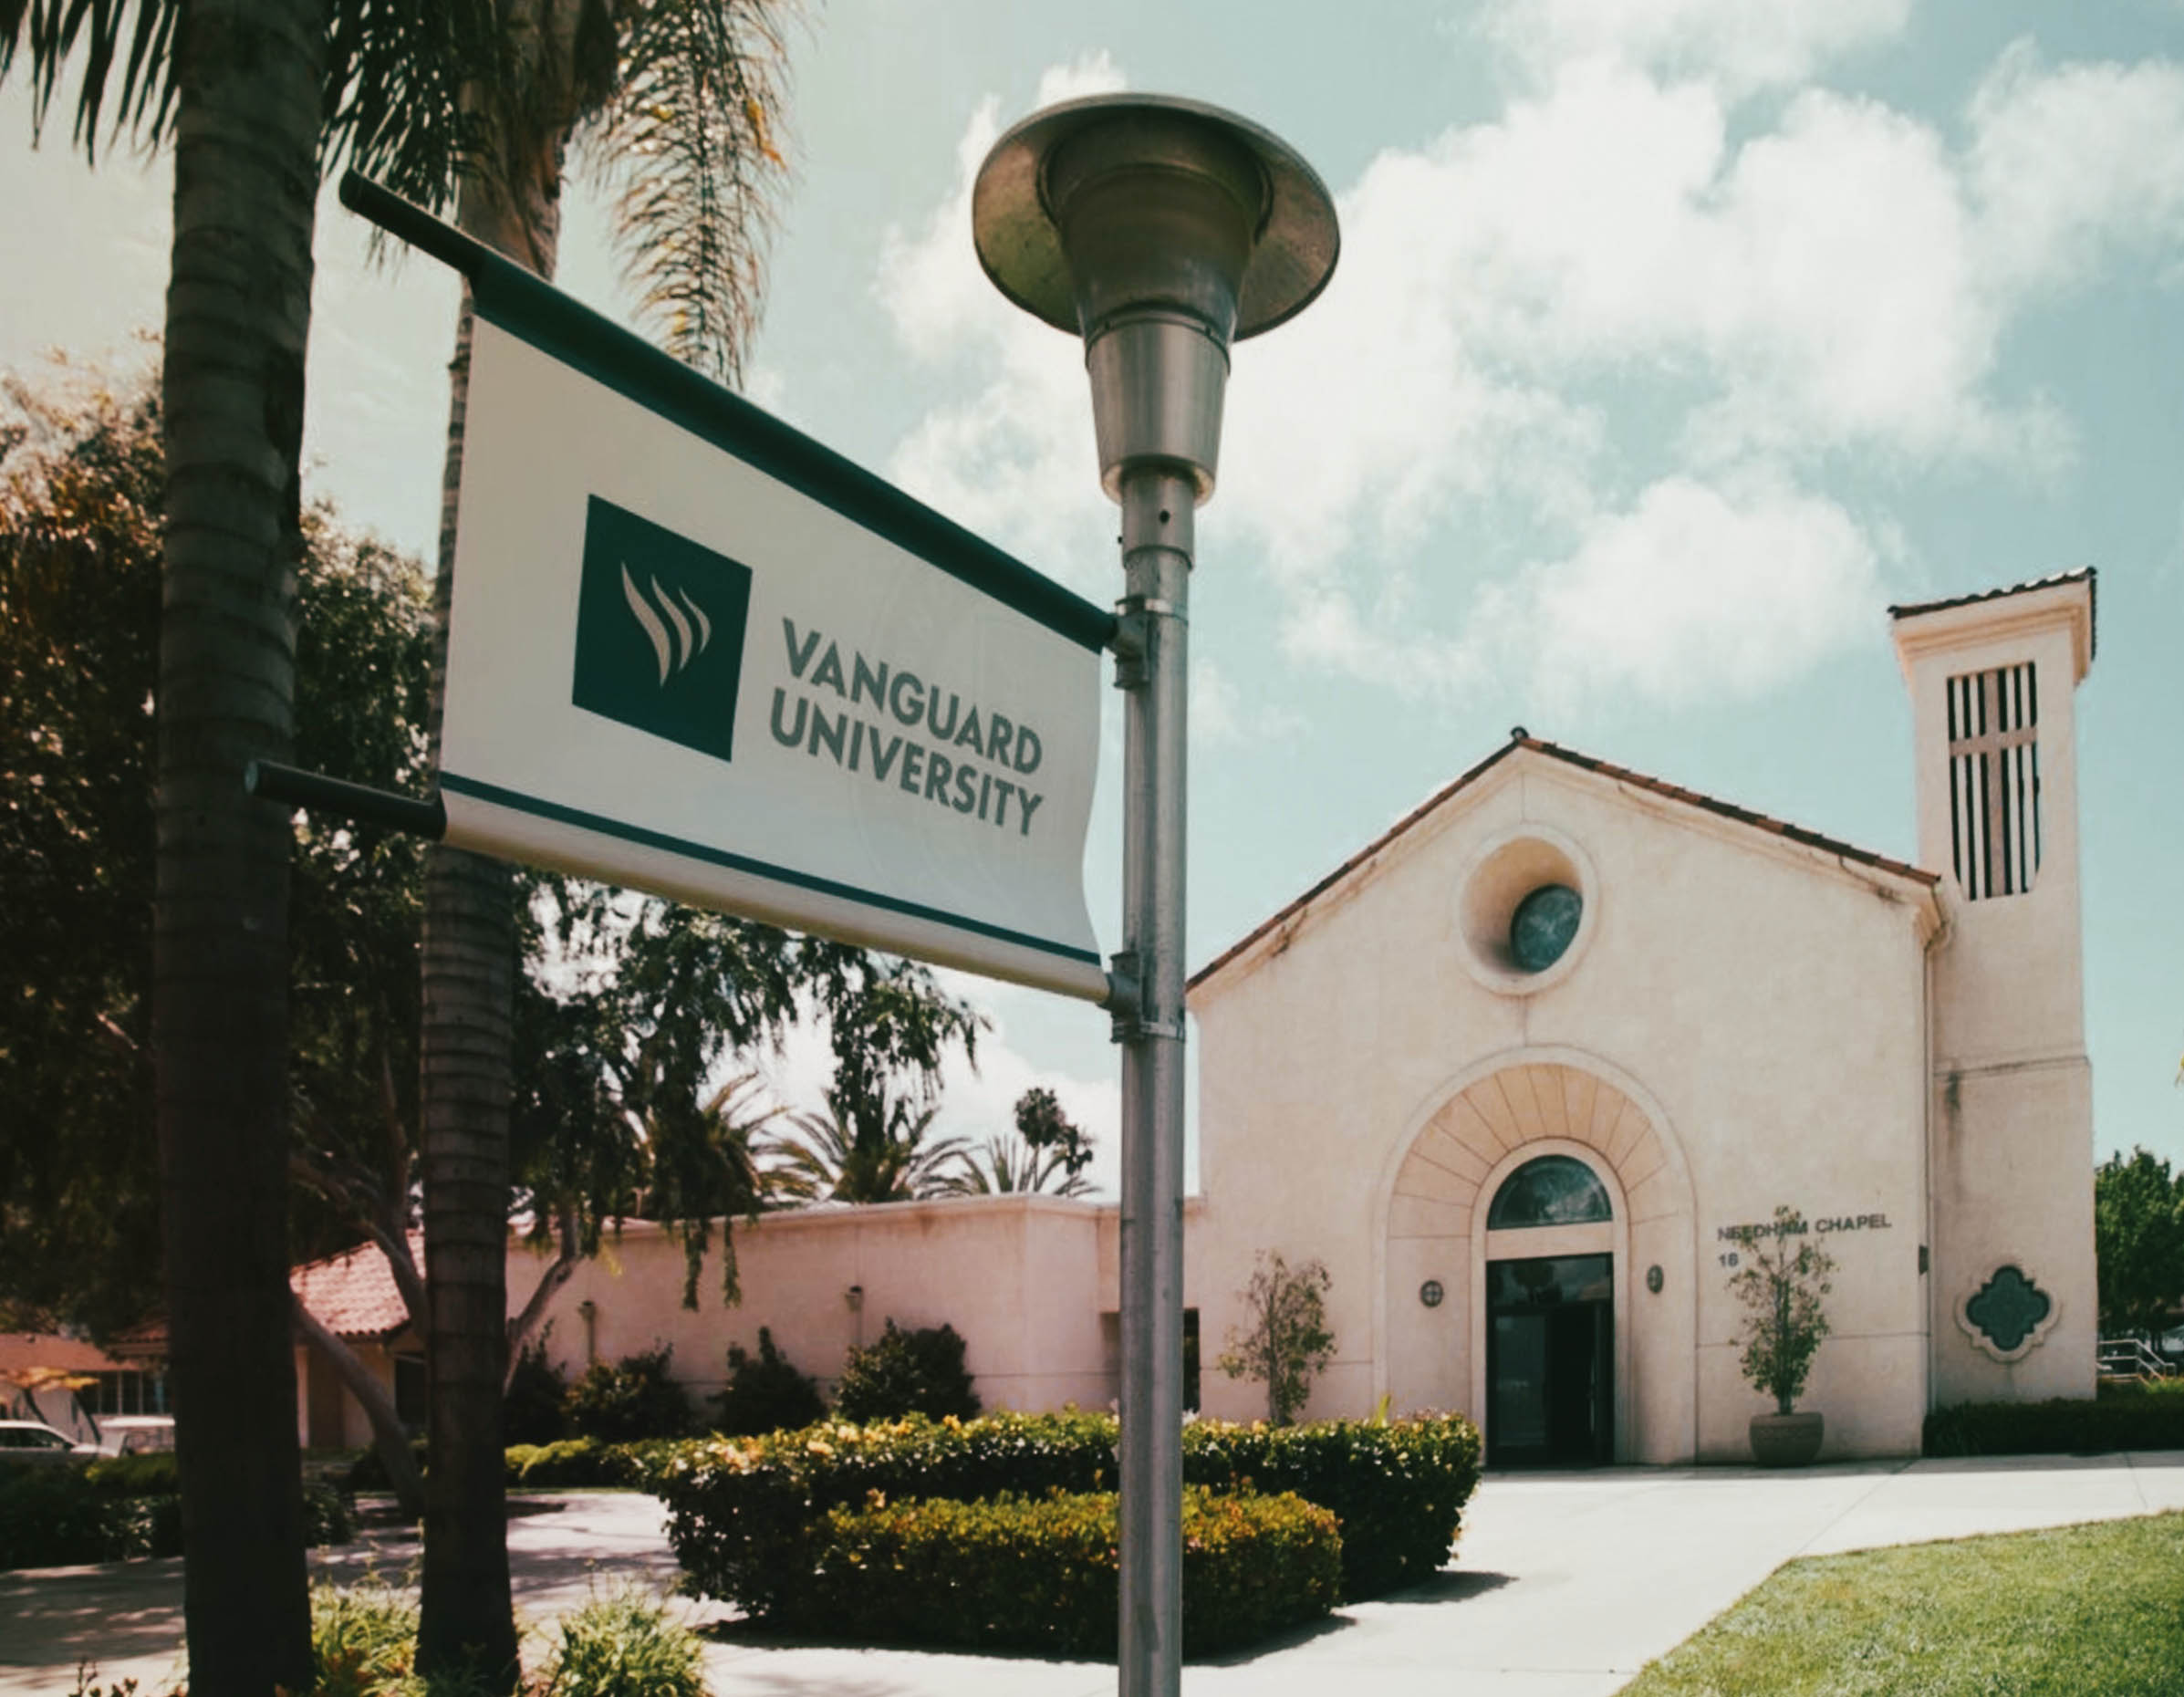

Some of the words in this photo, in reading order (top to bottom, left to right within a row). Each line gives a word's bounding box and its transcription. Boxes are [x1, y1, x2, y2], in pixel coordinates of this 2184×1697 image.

[771, 686, 1044, 837] UNIVERSITY
[783, 616, 1042, 775] VANGUARD
[1815, 1213, 1892, 1233] CHAPEL
